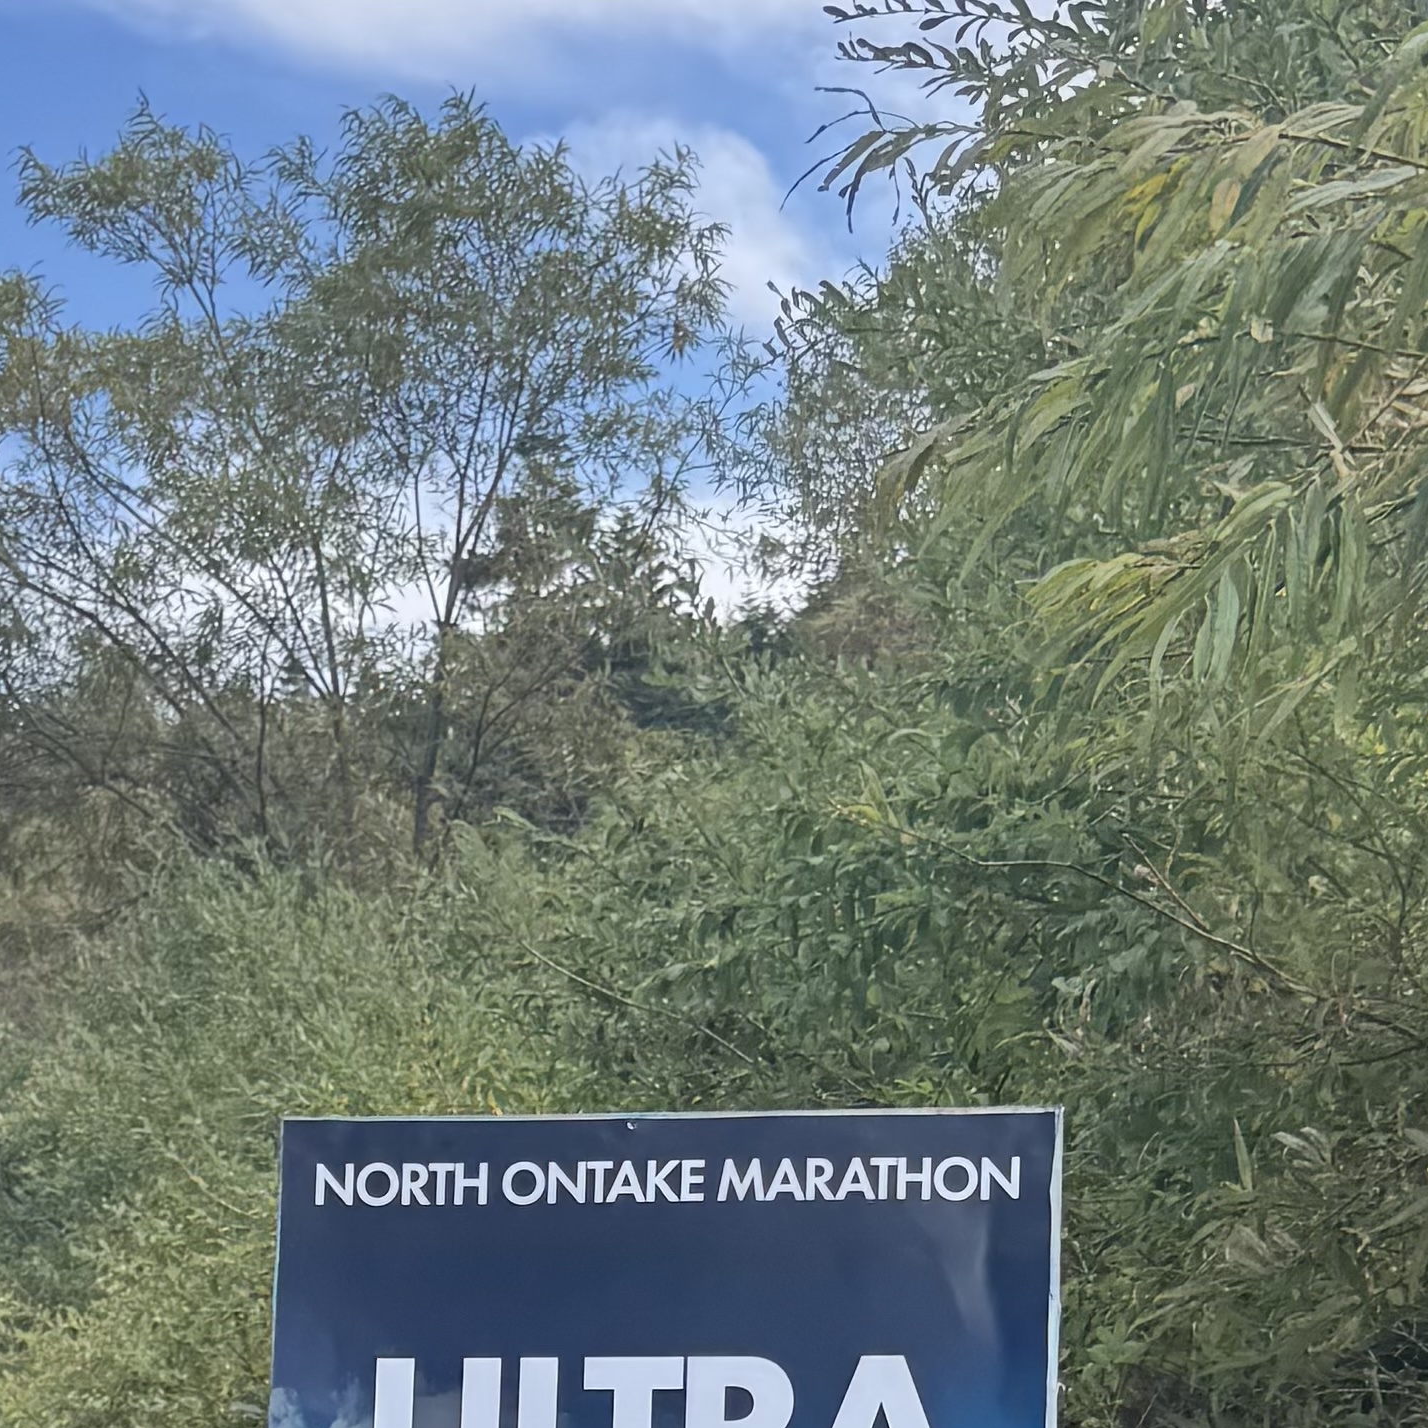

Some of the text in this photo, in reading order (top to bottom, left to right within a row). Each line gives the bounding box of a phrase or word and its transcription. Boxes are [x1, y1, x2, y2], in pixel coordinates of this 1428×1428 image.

[314, 1156, 1021, 1207] NORTH ONTAKE MARATHON
